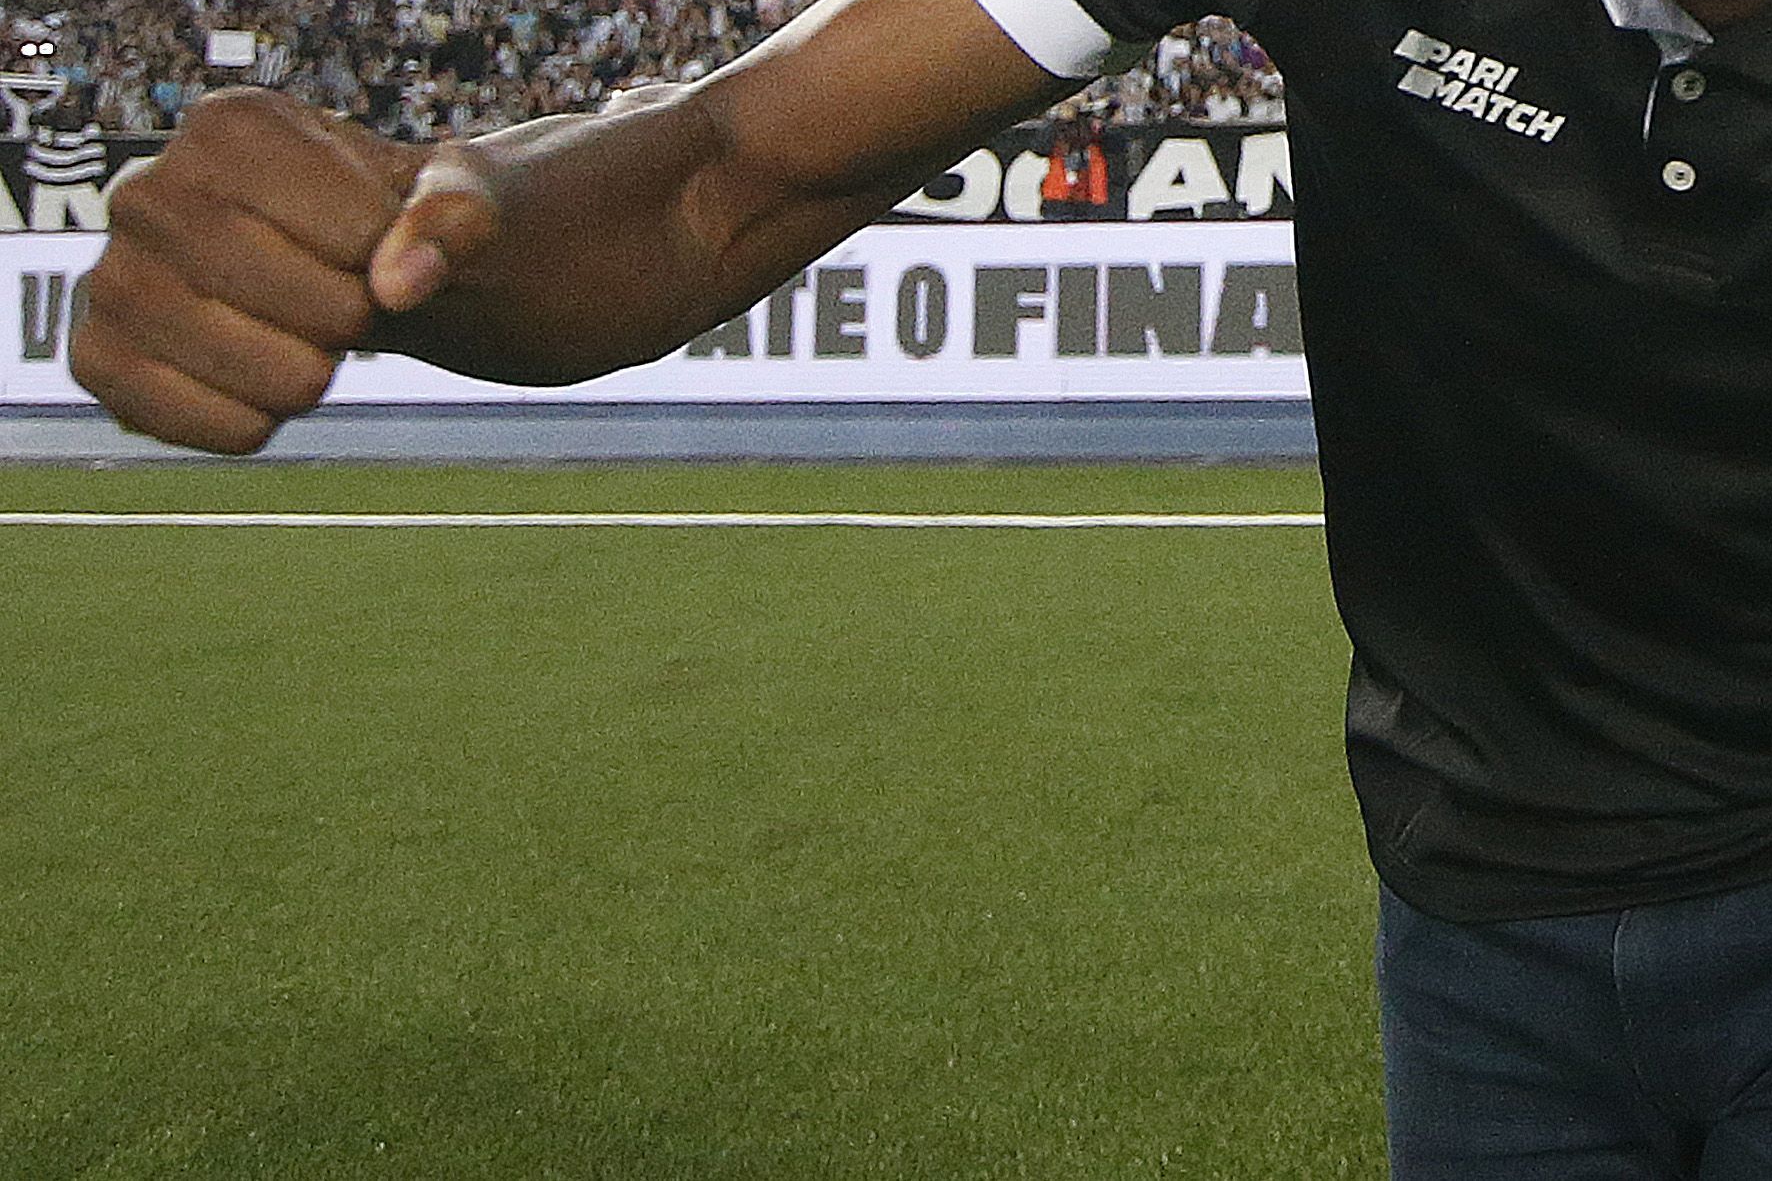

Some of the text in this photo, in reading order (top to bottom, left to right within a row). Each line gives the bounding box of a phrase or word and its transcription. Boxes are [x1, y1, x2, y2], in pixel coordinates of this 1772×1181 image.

[1394, 29, 1519, 92] PARI
[1397, 65, 1566, 142] MATCH
[898, 265, 948, 359] O
